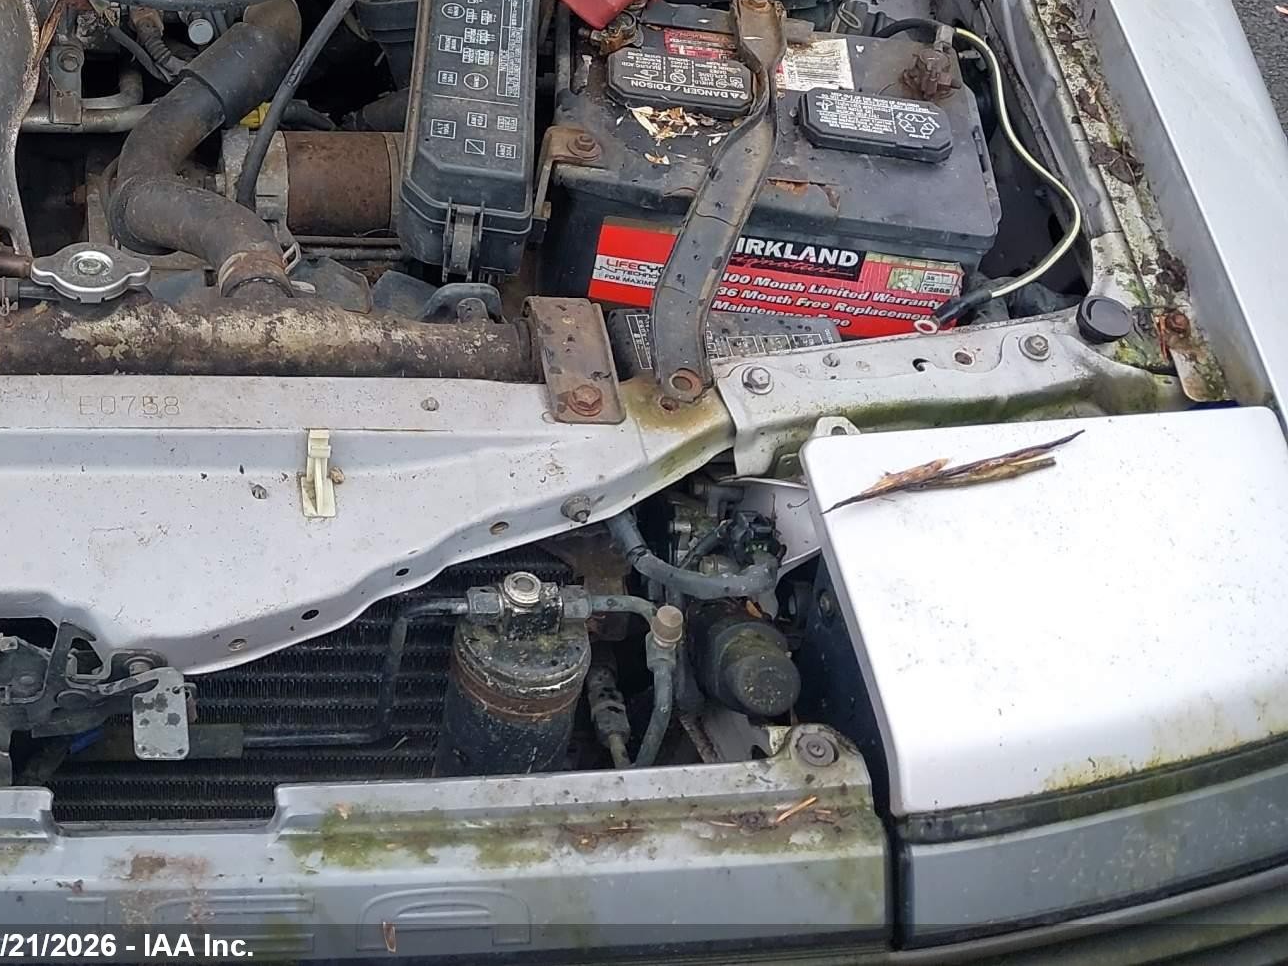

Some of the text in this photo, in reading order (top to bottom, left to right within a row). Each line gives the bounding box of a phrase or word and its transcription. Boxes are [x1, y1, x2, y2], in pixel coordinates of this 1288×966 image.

[631, 79, 672, 91] POISON
[683, 87, 729, 99] DANGER
[736, 237, 859, 267] IRKLAND
[621, 270, 658, 279] TECHNO
[722, 272, 943, 310] 100 Month Limited Warranty
[717, 286, 931, 320] 36 Month Free Replacemen
